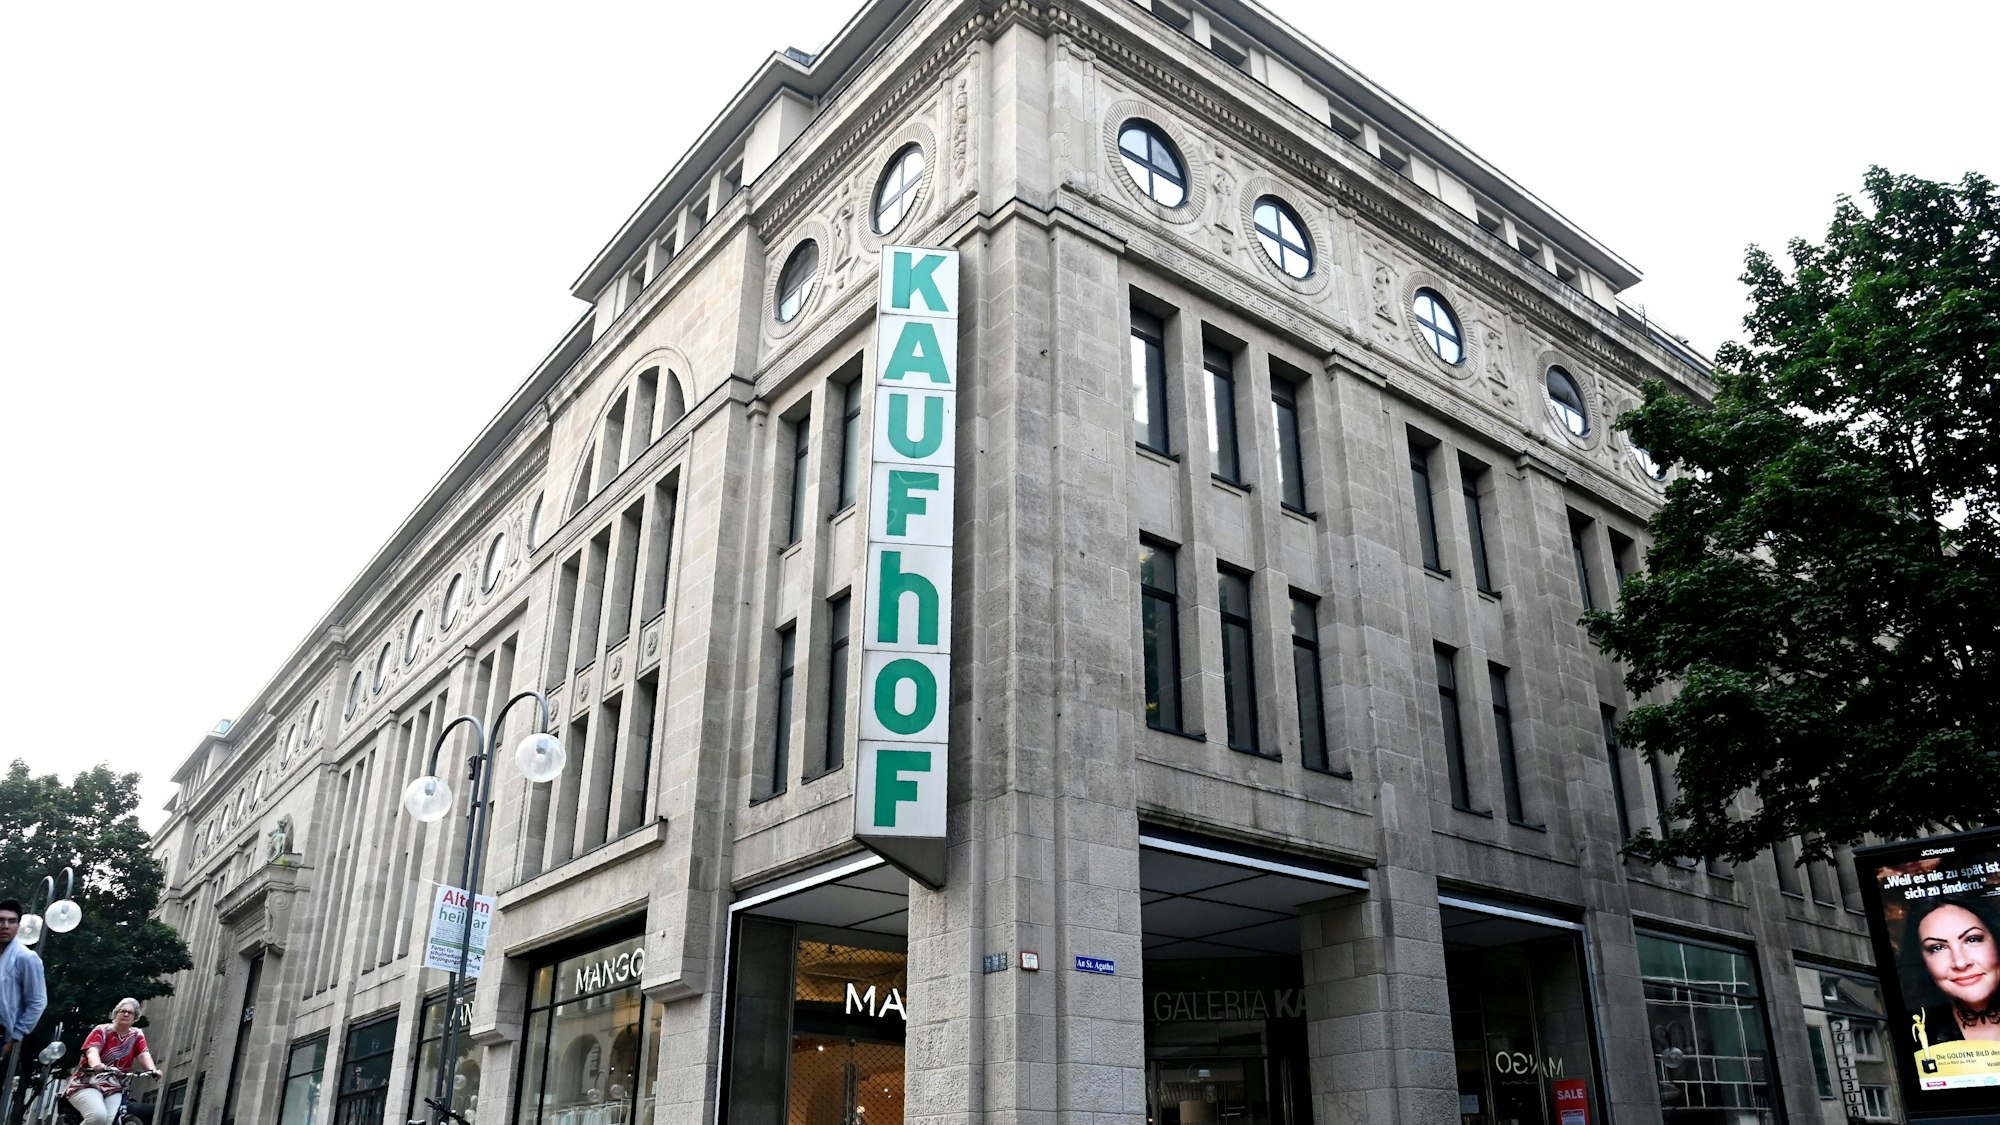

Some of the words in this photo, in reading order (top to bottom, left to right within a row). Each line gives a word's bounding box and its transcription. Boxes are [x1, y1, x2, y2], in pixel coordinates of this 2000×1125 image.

[1921, 847, 1955, 857] JCDecaux
[1913, 874, 1926, 884] es
[1927, 870, 1943, 882] nie
[1945, 869, 1958, 879] zu
[1961, 863, 1985, 878] spät
[1904, 886, 1926, 900] sich
[1927, 885, 1941, 897] zu
[439, 906, 487, 930] heilar
[575, 947, 645, 995] MANGO
[1077, 959, 1086, 967] An
[1086, 960, 1094, 968] St.
[1095, 961, 1114, 972] Agatha
[845, 982, 908, 1021] MA
[1153, 989, 1270, 1022] GALERIA
[1947, 1051, 1975, 1059] GOLDENE
[1556, 1088, 1584, 1101] SALE
